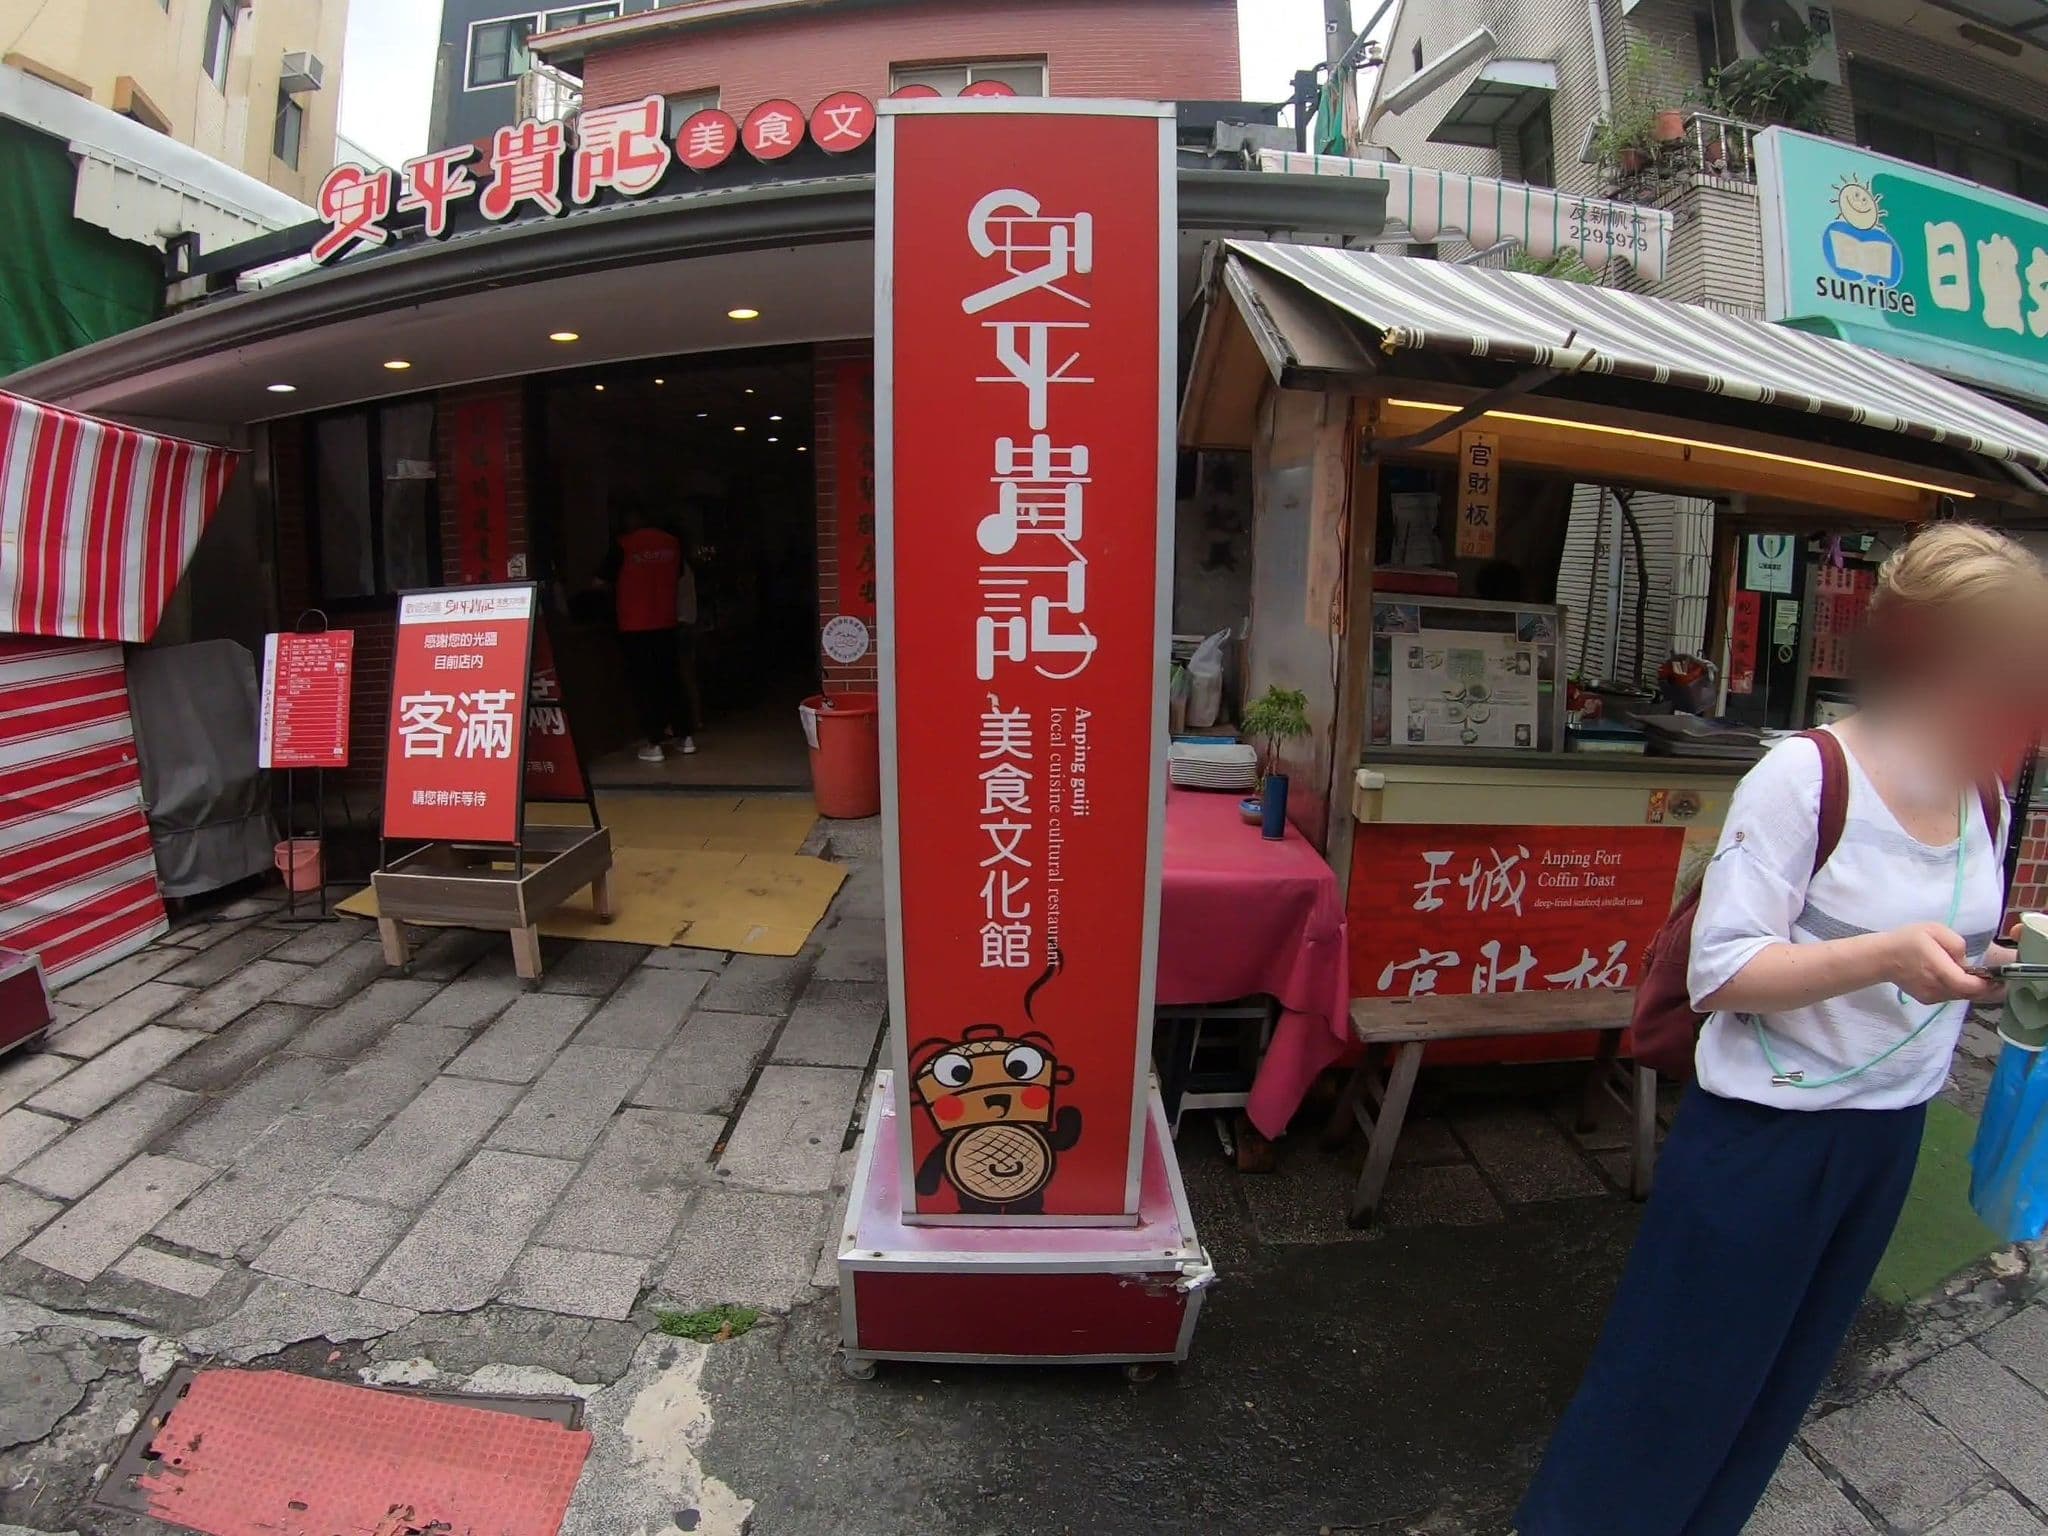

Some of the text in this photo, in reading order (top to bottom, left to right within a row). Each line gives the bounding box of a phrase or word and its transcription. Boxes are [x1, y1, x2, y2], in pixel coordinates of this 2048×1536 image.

[689, 103, 864, 159] 美食文
[312, 97, 670, 262] 安平貴記
[1569, 225, 1649, 252] 2295979
[1816, 275, 1915, 315] sunrise
[961, 188, 1098, 681] 安平貴記
[1465, 441, 1492, 527] 官財板
[398, 688, 516, 759] 客滿
[1069, 706, 1092, 817] Anping guiji
[412, 790, 488, 808] 請您稍作等待
[978, 703, 1033, 968] 美食文化館
[1046, 707, 1067, 967] local cuisine cultural restaurant
[1541, 849, 1622, 868] Anping Fort
[1412, 844, 1531, 918] 王城
[1537, 871, 1616, 888] Coffin Toast
